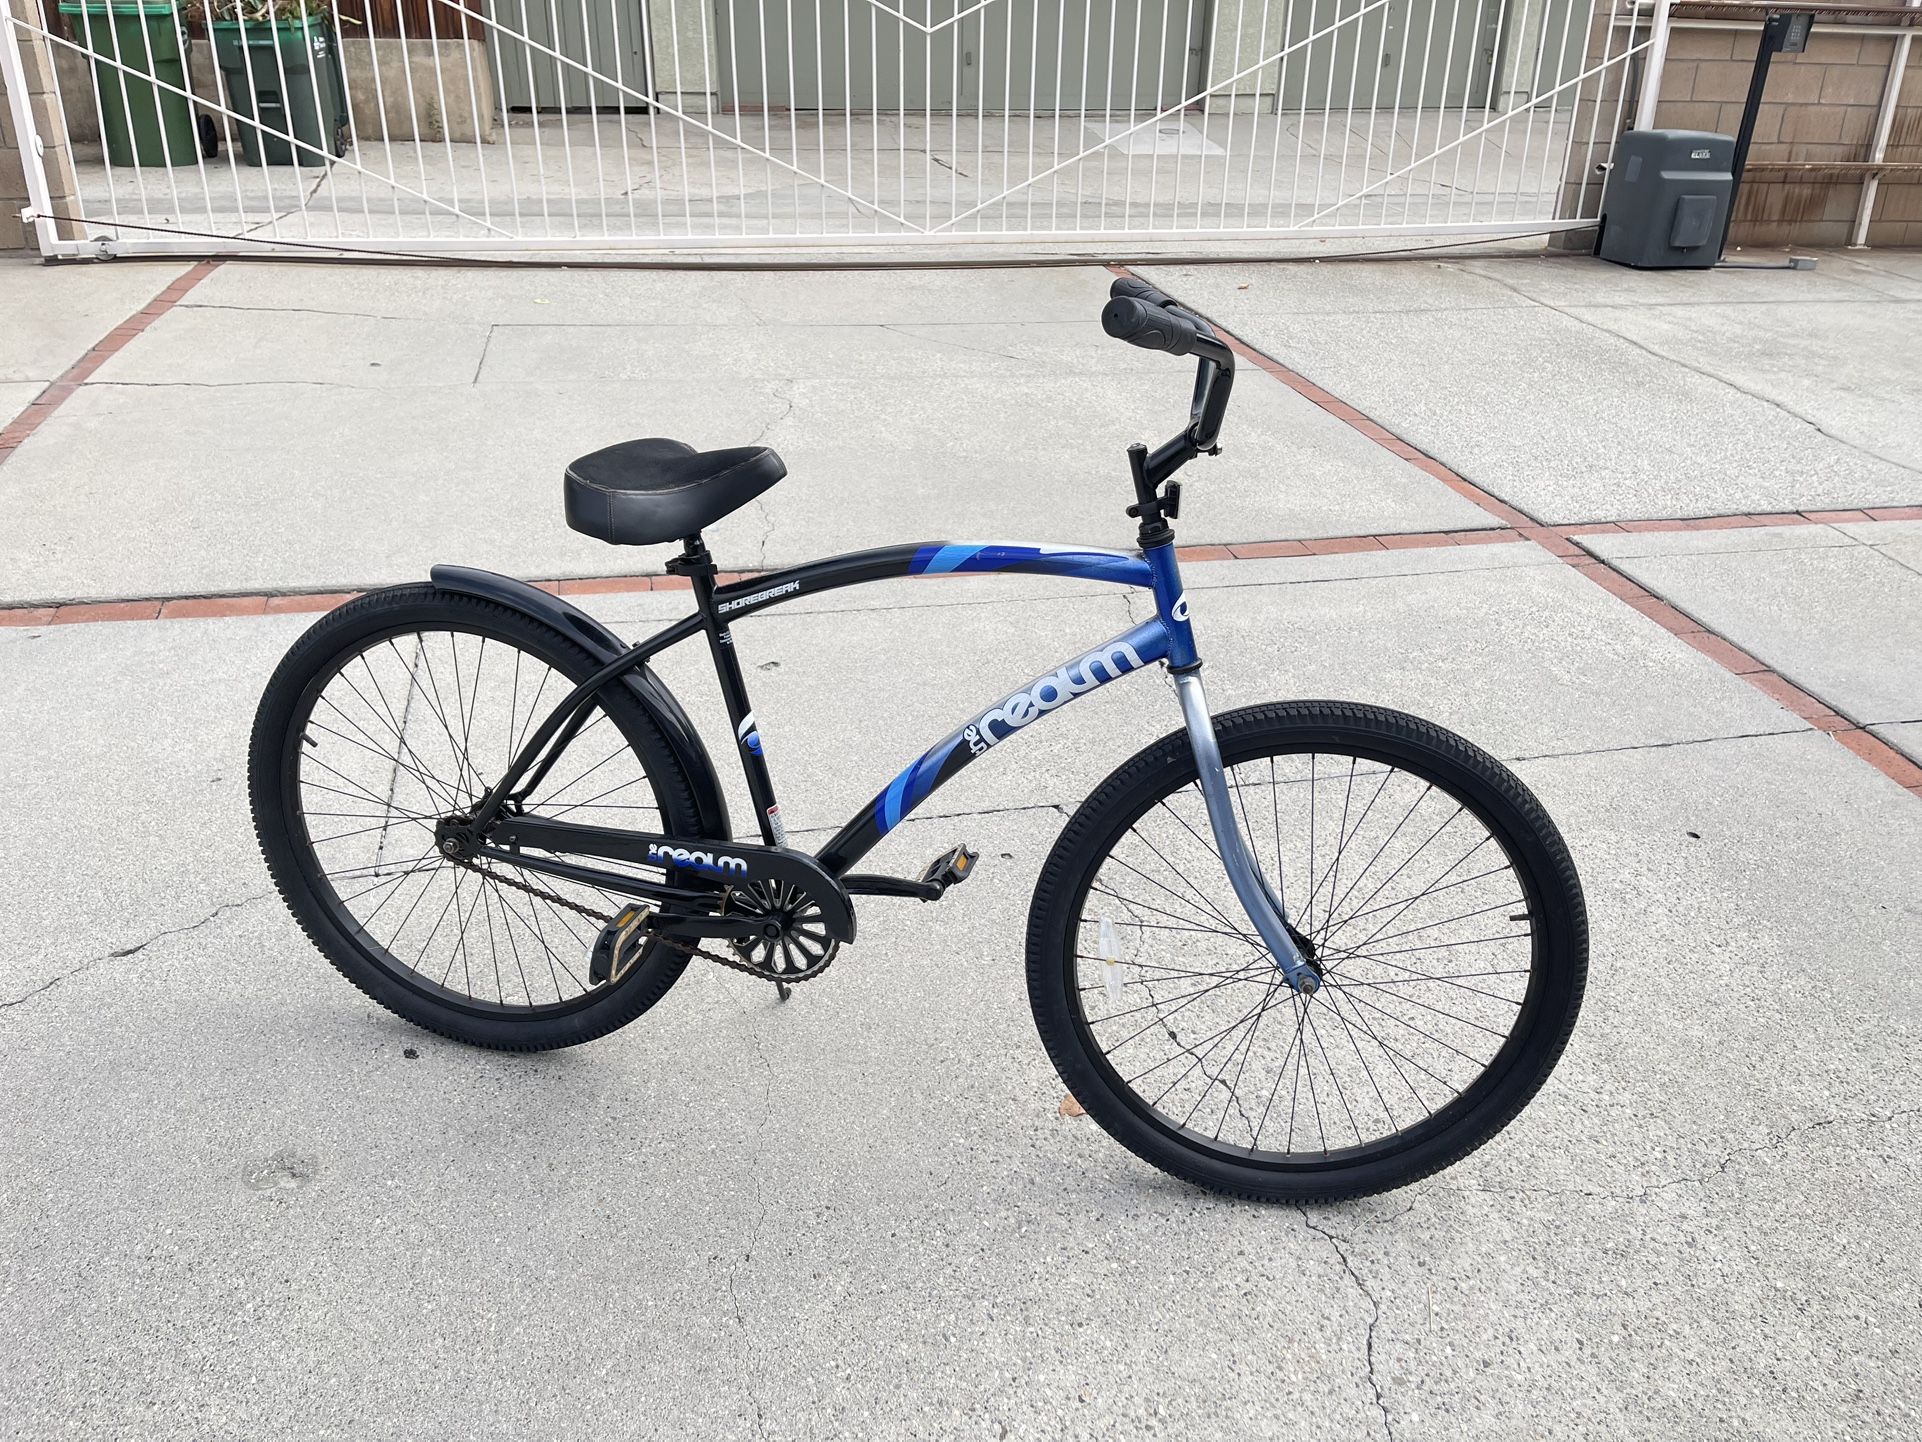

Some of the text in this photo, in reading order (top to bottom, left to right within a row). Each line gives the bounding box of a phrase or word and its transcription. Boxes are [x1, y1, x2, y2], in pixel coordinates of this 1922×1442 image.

[718, 580, 800, 614] SHOREBREAK
[979, 641, 1145, 747] realm
[657, 845, 748, 878] realm
